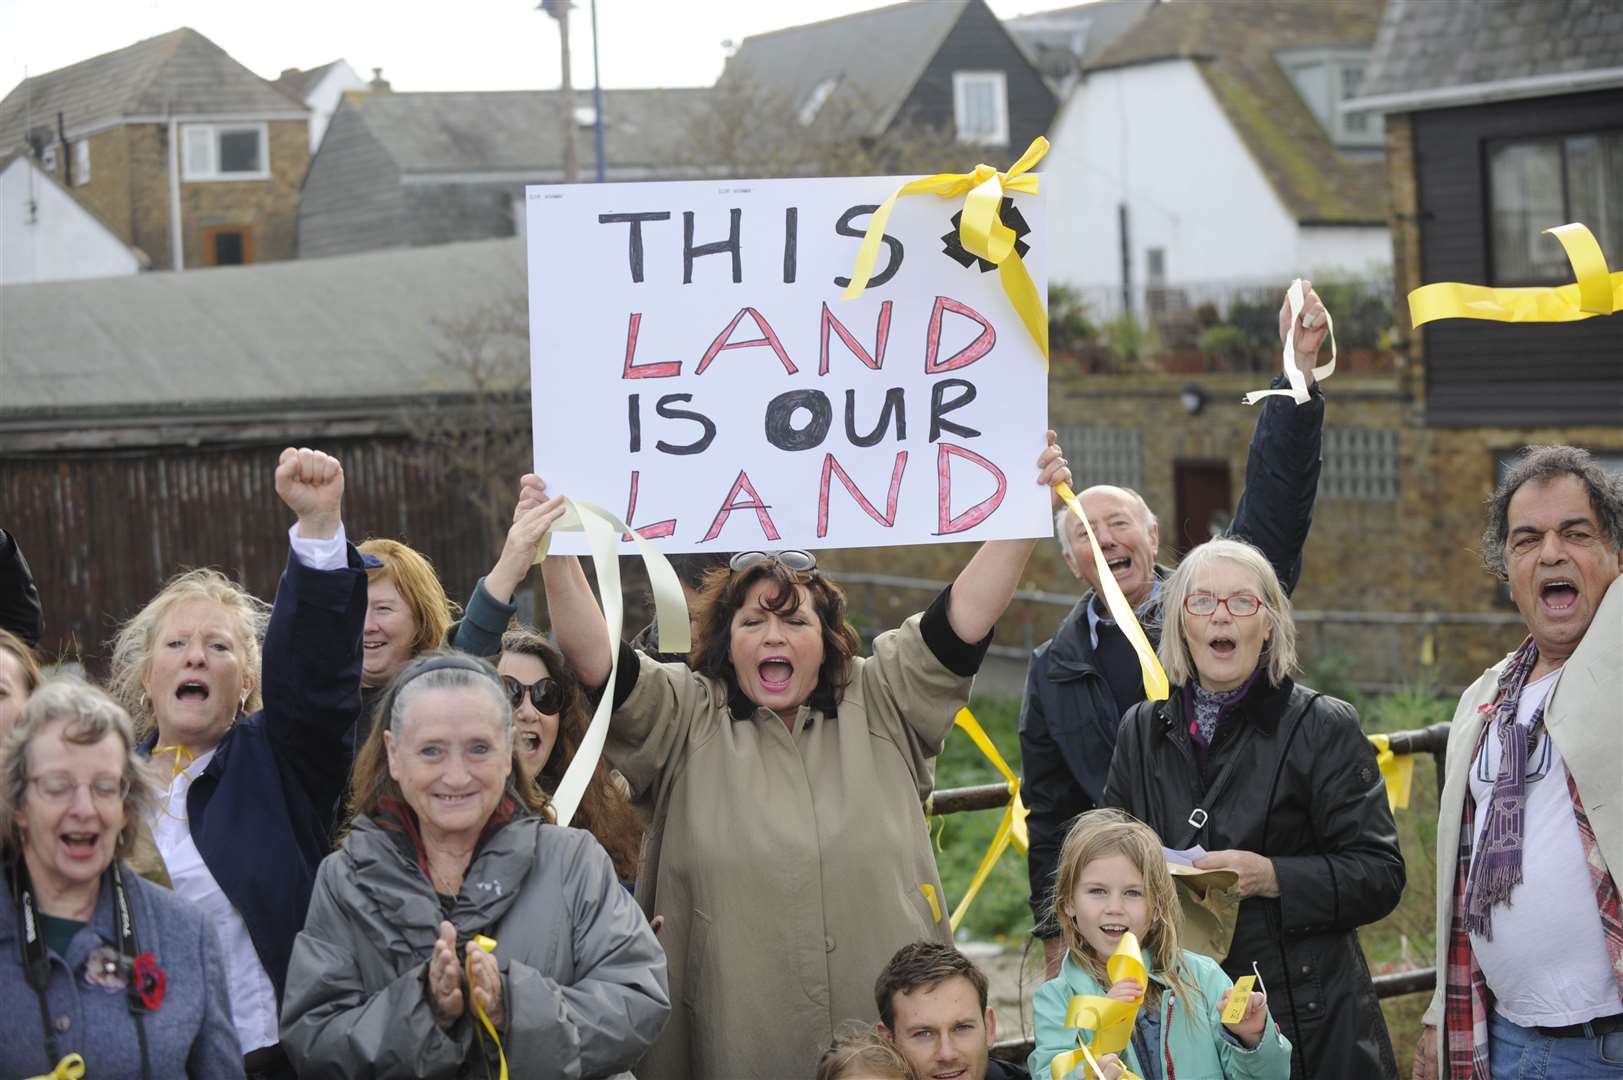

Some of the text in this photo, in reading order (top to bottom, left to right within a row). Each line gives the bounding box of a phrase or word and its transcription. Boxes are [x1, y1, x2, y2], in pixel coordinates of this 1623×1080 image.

[598, 204, 904, 288] THIS
[622, 296, 996, 379] LAND
[628, 379, 981, 455] IS OUR
[622, 442, 1007, 543] LAND
